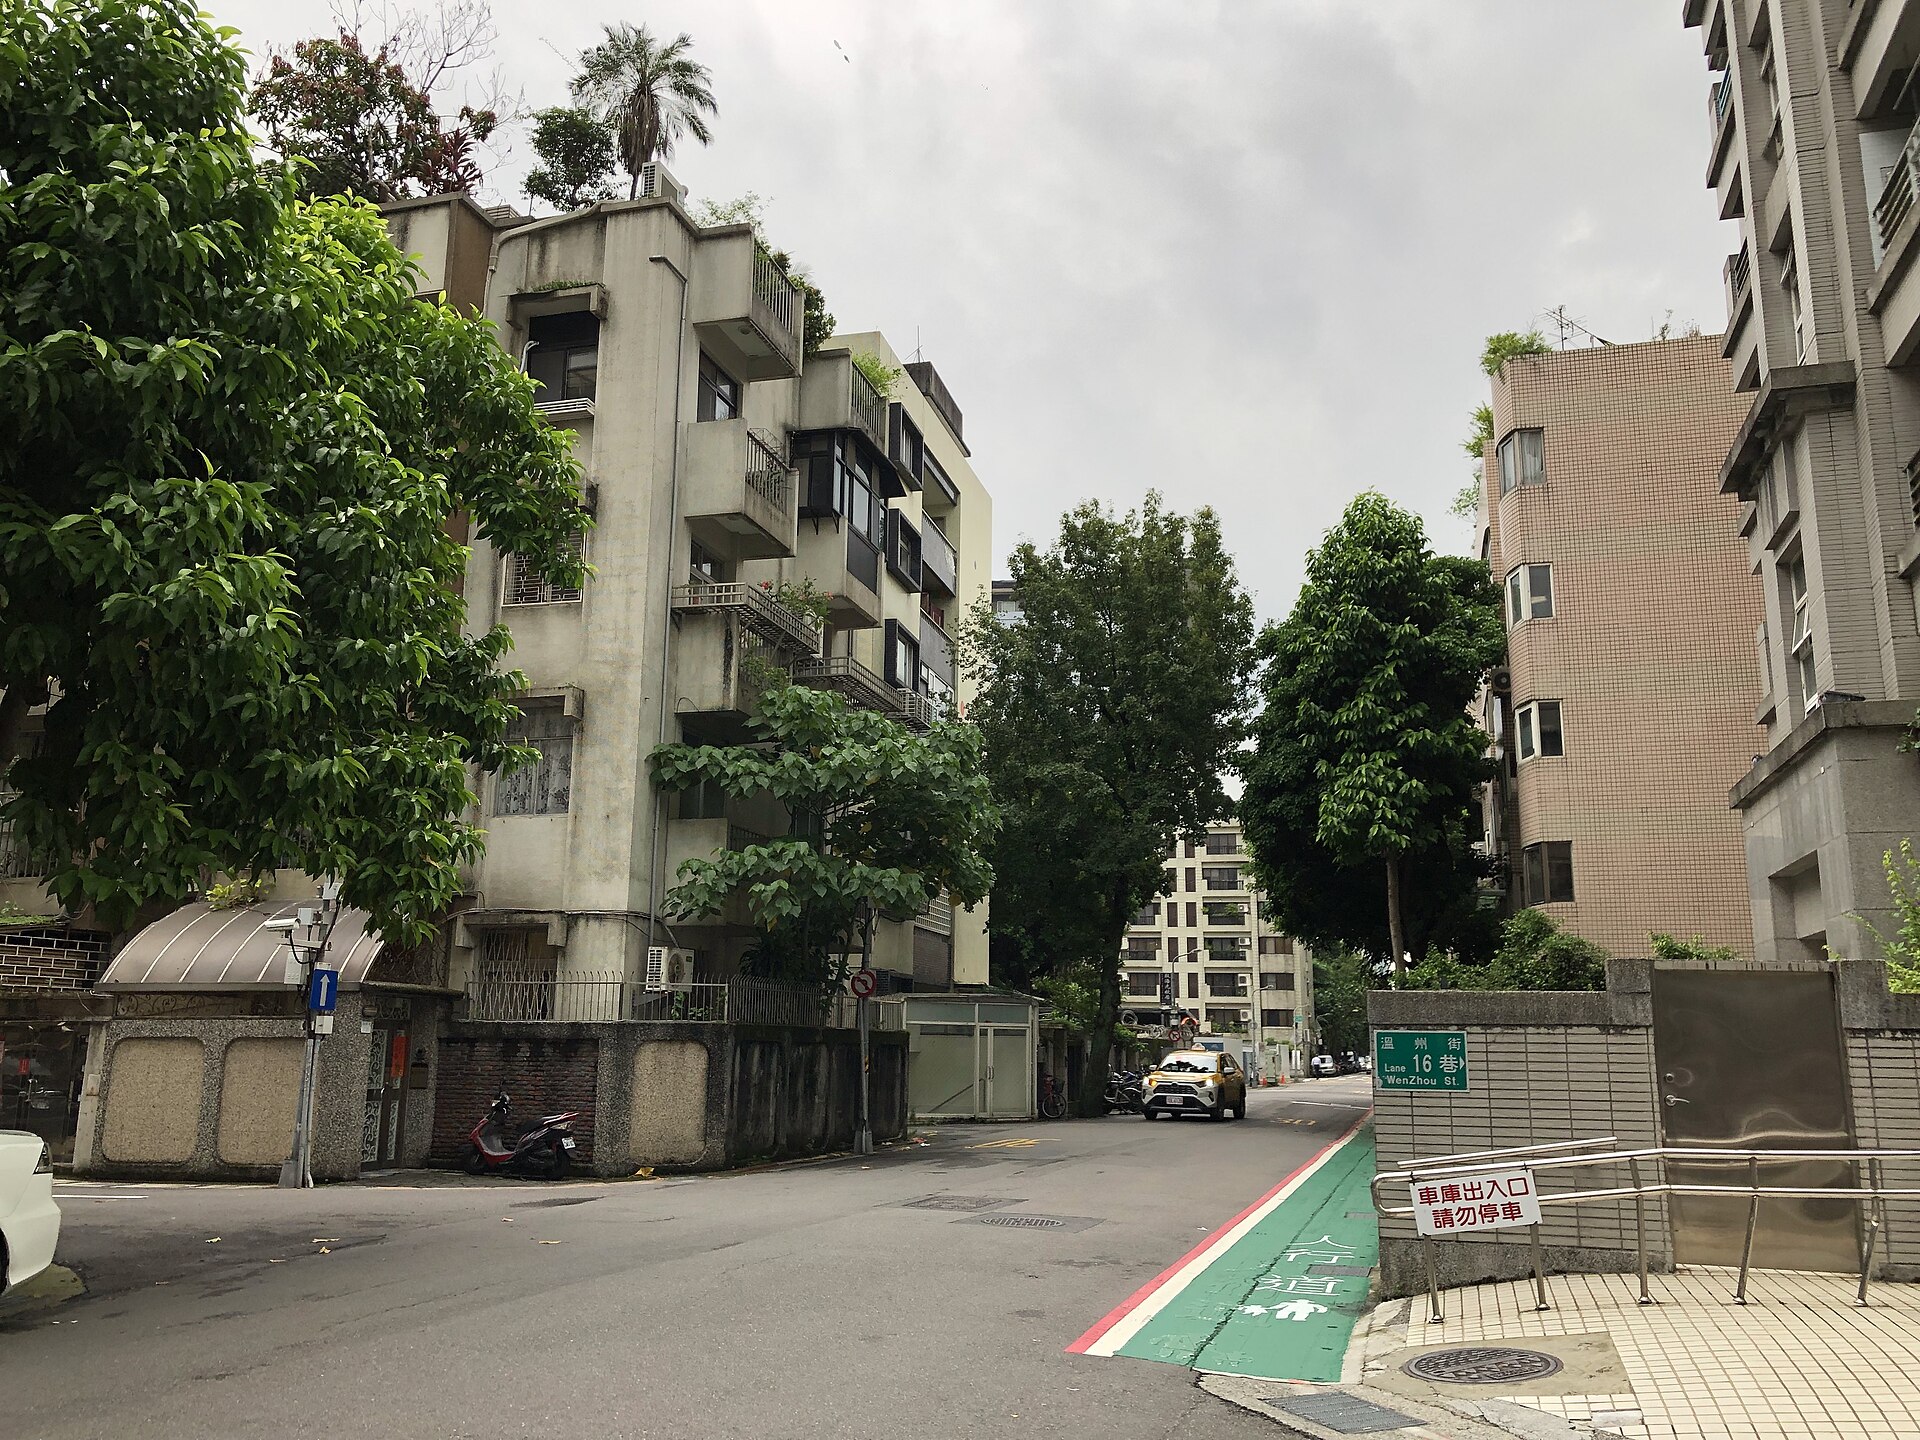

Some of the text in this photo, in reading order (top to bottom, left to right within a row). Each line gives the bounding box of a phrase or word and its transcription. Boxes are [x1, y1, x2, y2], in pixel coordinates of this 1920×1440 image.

[1384, 1054, 1459, 1073] Lane 16 巷
[1386, 1075, 1460, 1086] WenZhou St.
[1418, 1177, 1529, 1206] 車庫出入口
[1432, 1201, 1524, 1229] 請勿停車
